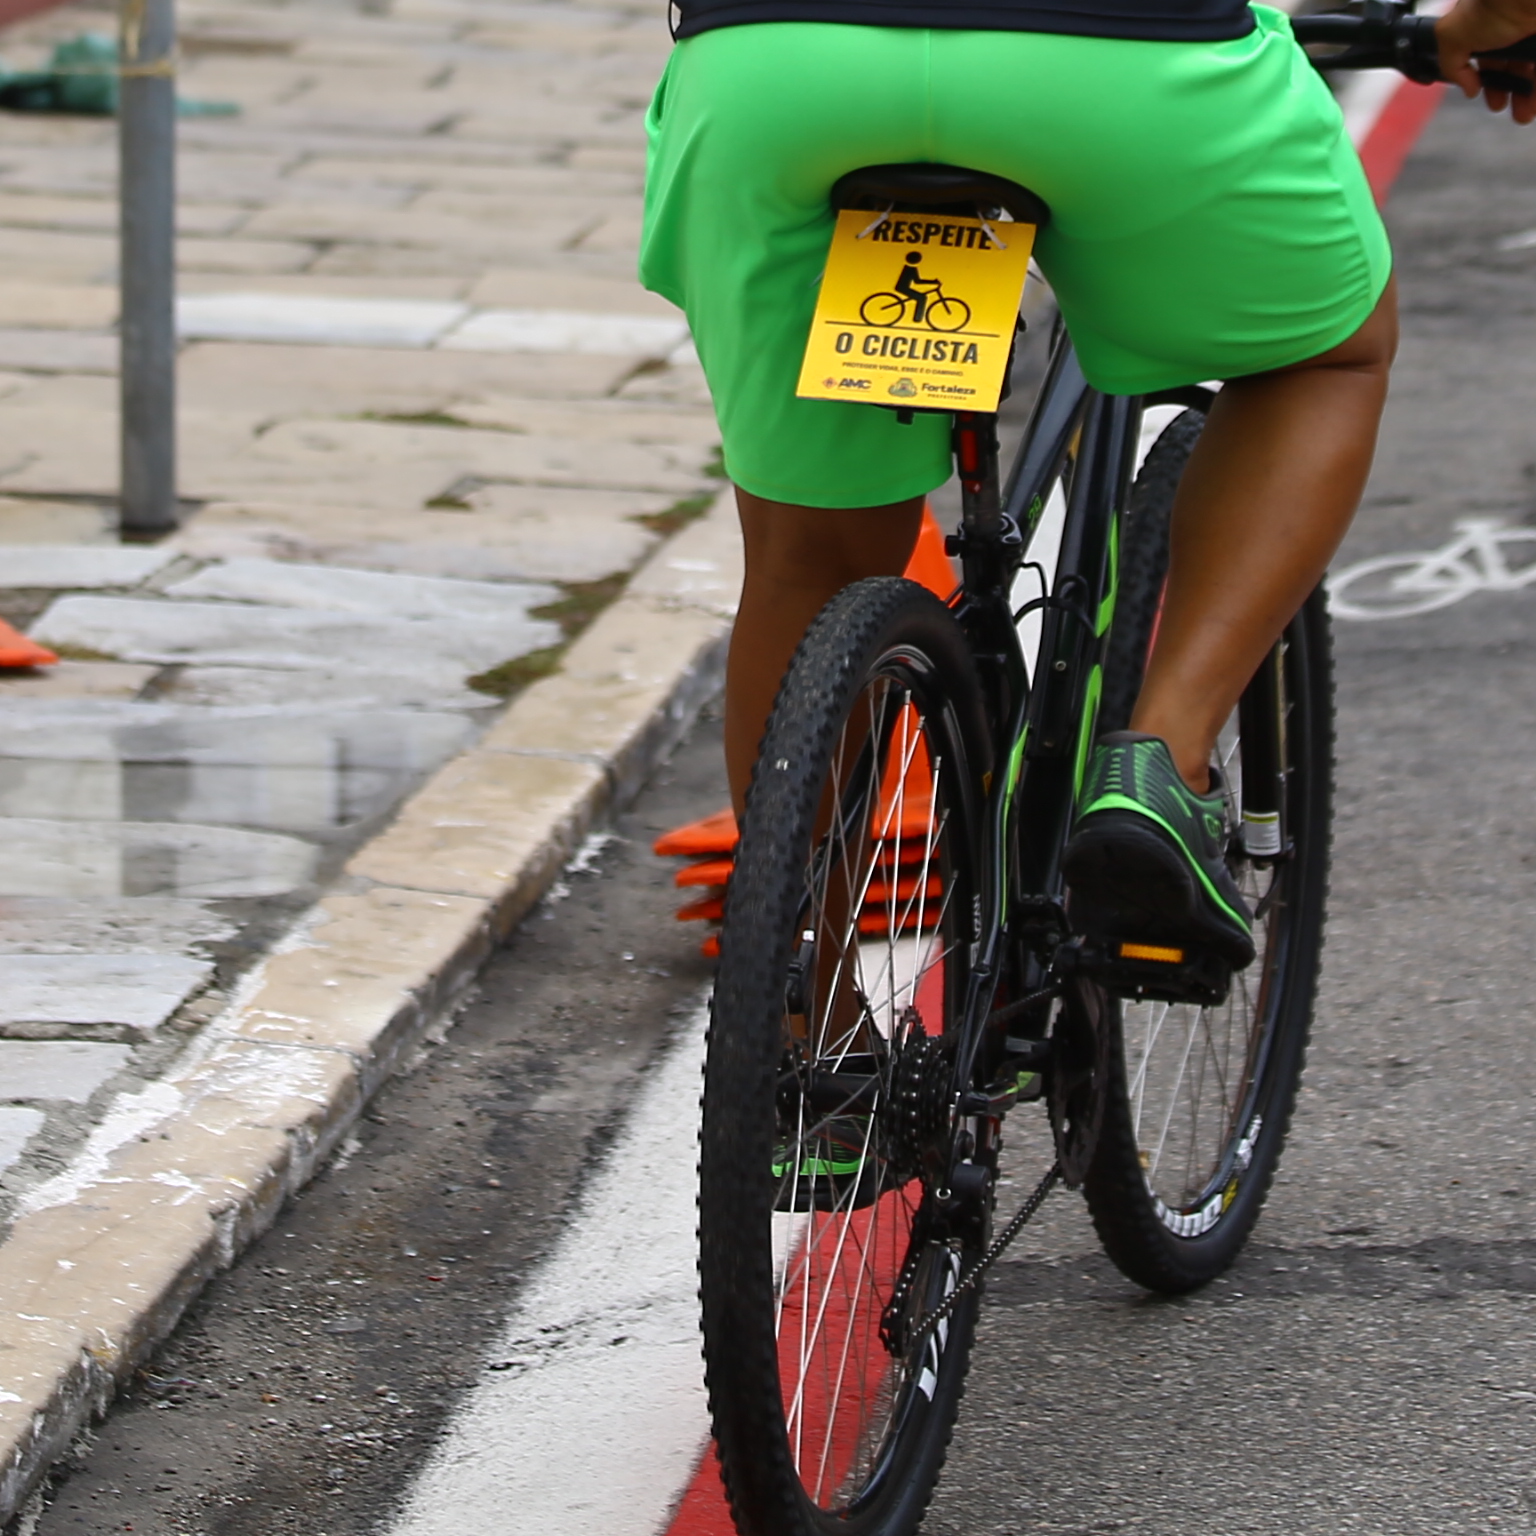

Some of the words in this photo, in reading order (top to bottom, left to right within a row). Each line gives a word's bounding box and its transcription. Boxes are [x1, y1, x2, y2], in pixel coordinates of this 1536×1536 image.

[872, 219, 996, 251] RESPEITE
[835, 331, 854, 355] O
[862, 334, 979, 365] CICLISTA
[838, 378, 872, 390] AMC
[921, 382, 976, 395] Fortaleza
